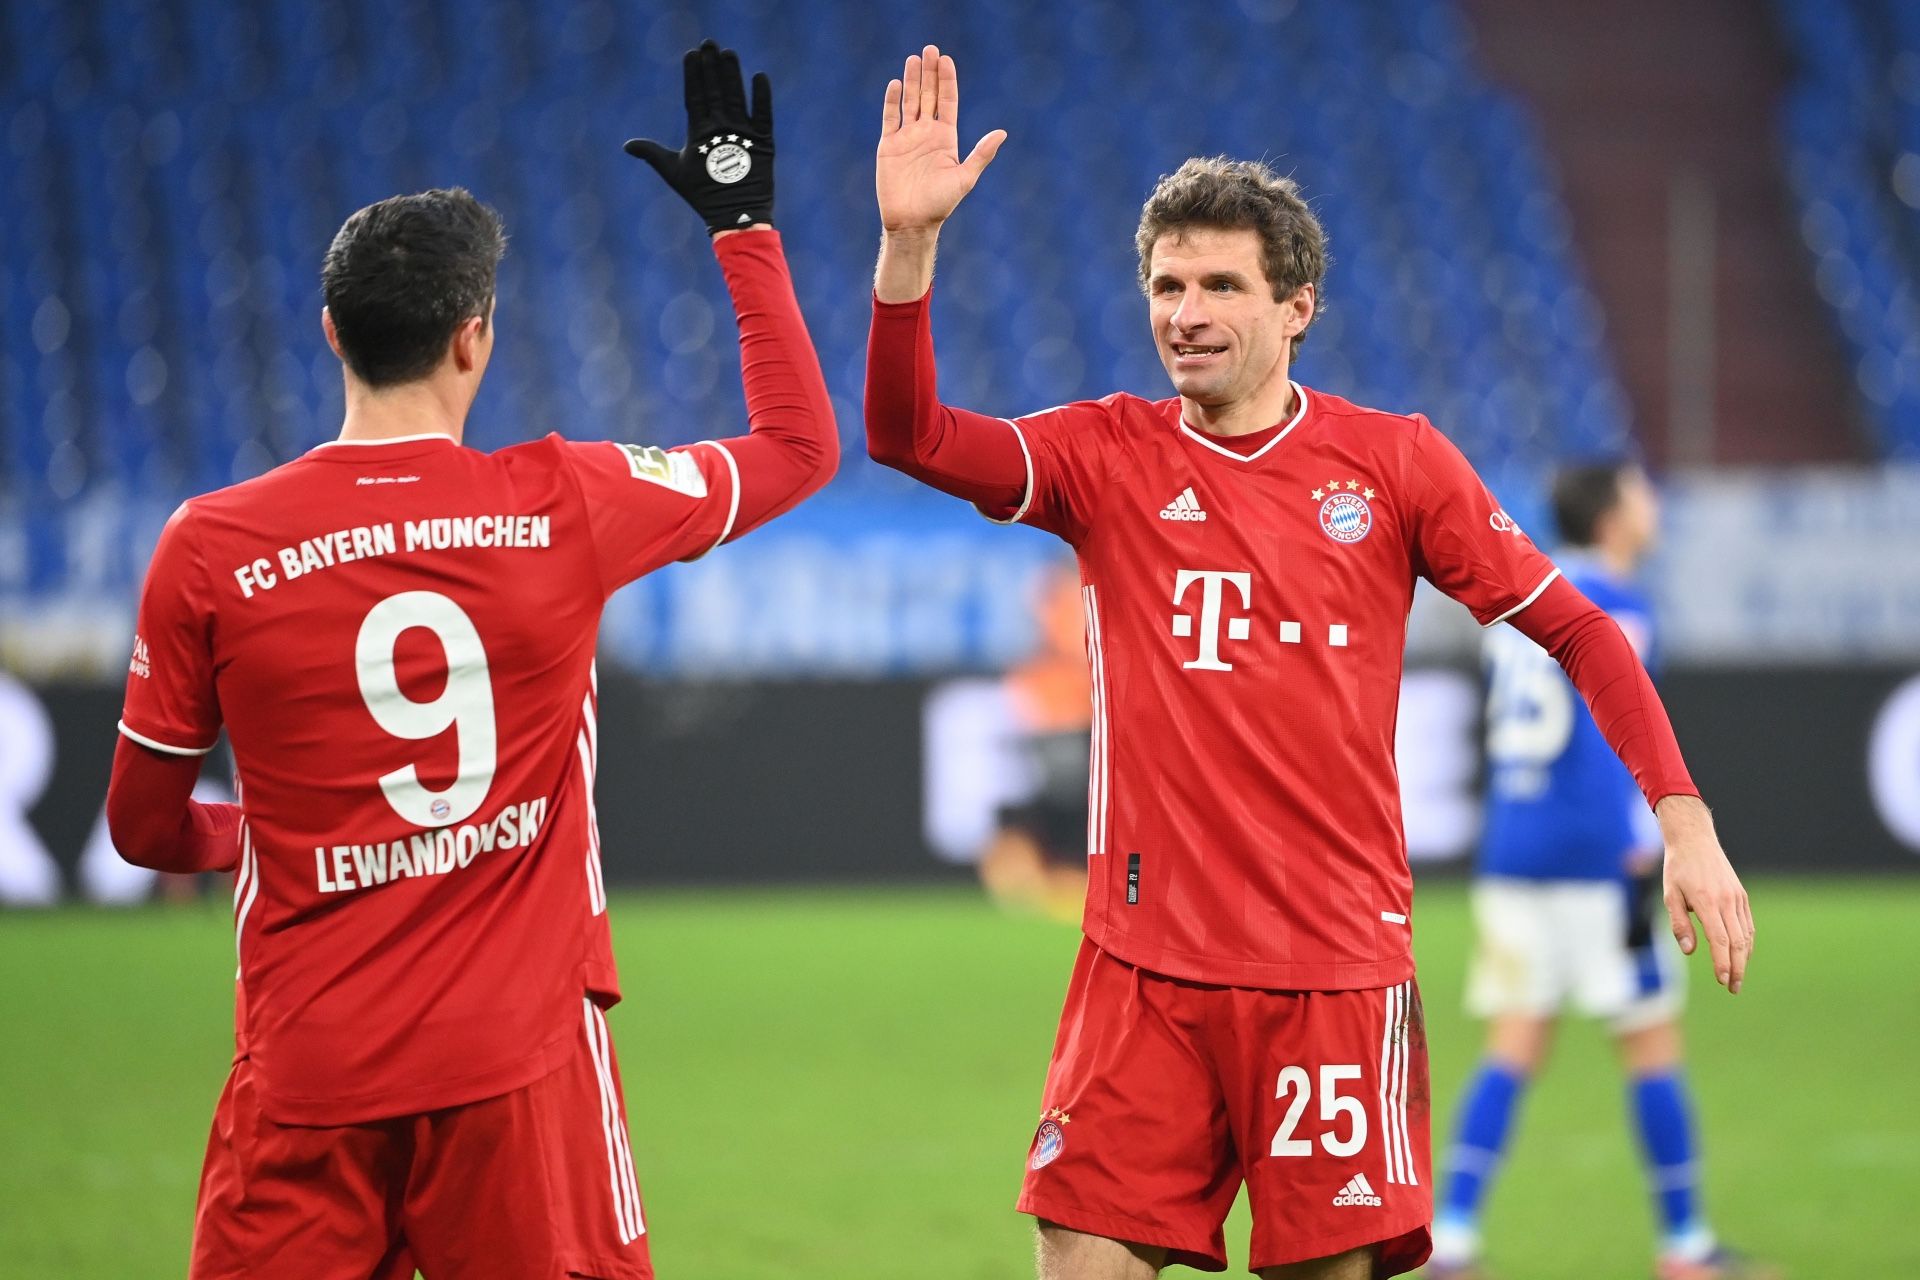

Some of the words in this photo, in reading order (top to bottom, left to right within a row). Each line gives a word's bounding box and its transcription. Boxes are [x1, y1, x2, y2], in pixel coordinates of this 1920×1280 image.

[1159, 509, 1207, 521] adidas
[1324, 504, 1333, 515] FC
[1333, 496, 1367, 514] BAYERN
[234, 558, 277, 598] FC
[278, 523, 396, 580] BAYERN
[404, 515, 550, 552] MÜNCHEN
[355, 590, 497, 828] 9
[314, 796, 548, 893] LEWANDOWSKI
[1270, 1064, 1368, 1157] 25
[1332, 1193, 1382, 1207] adidas
